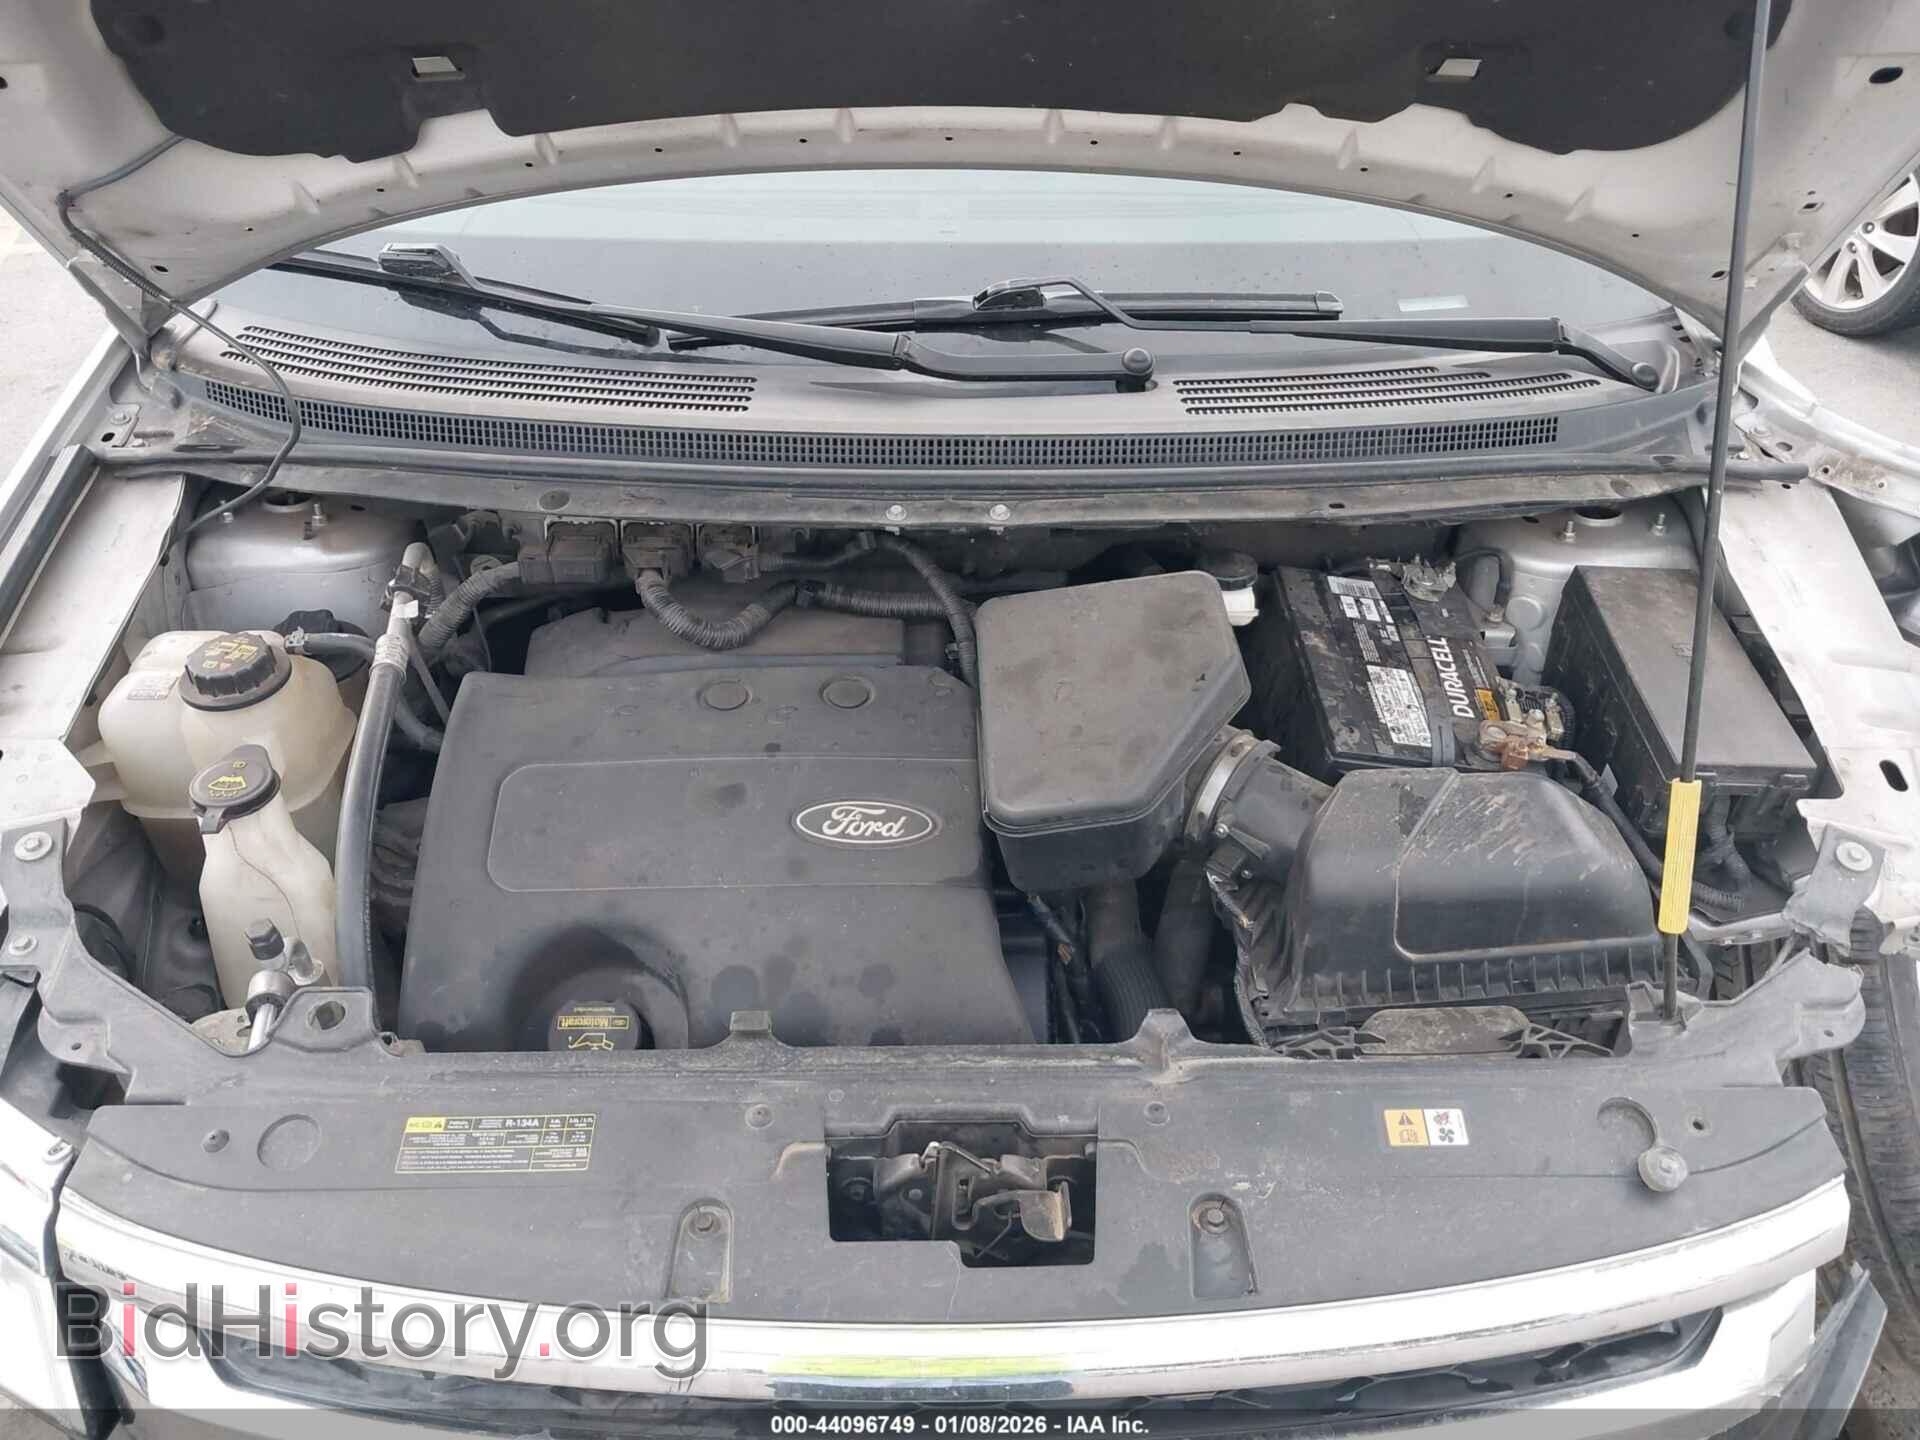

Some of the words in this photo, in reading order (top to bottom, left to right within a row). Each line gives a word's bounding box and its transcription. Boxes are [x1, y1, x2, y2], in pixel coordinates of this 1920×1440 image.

[1426, 636, 1476, 719] DURACELL
[822, 805, 907, 838] Ford
[561, 1017, 609, 1029] Motorcraft
[505, 1118, 540, 1128] R-134A
